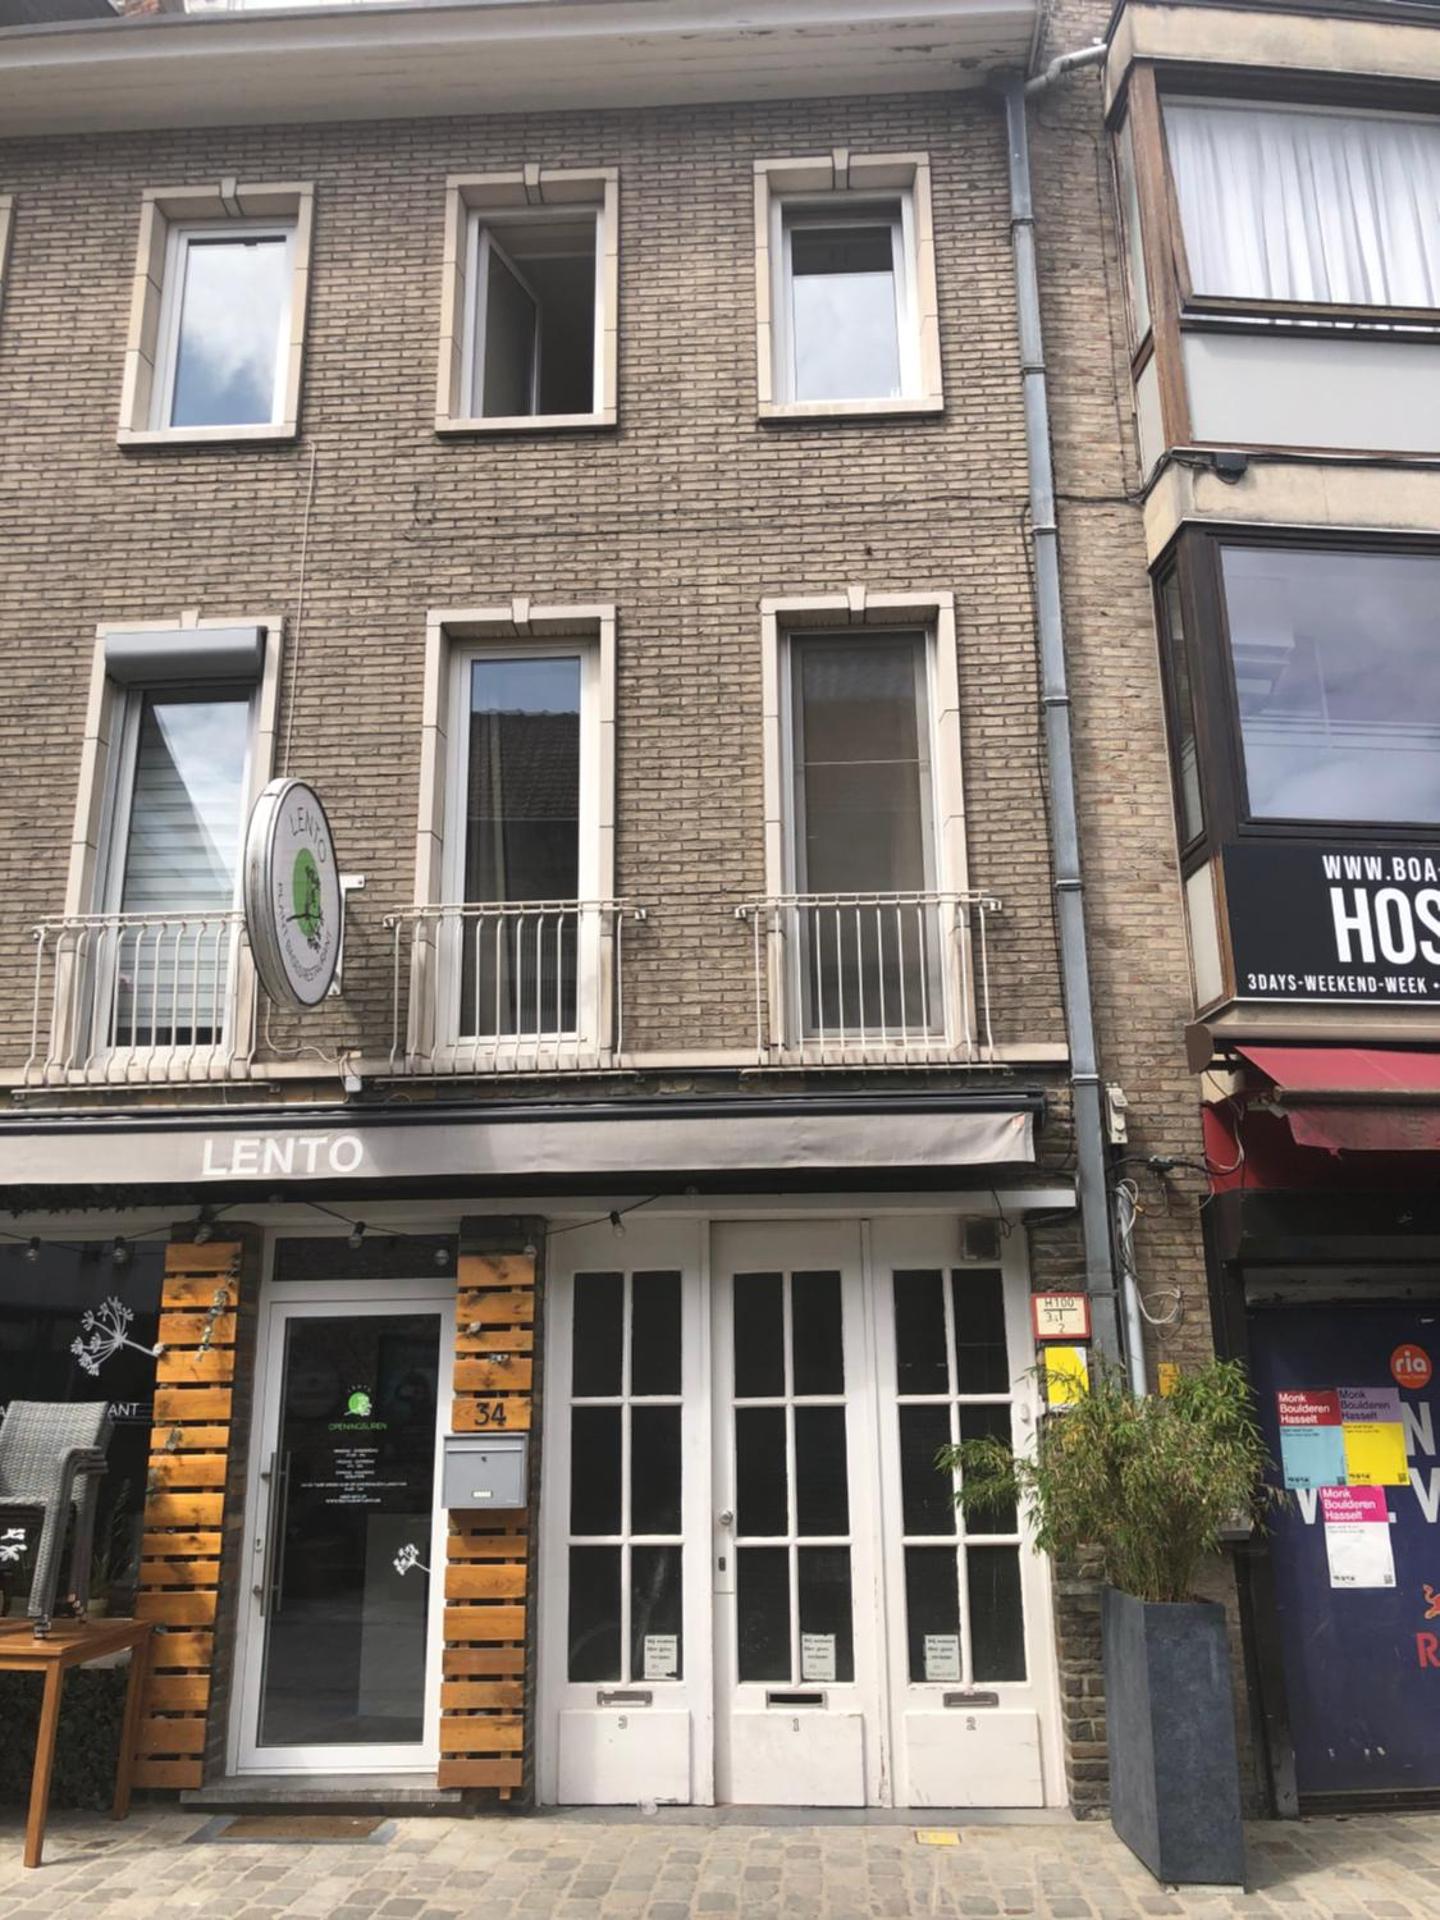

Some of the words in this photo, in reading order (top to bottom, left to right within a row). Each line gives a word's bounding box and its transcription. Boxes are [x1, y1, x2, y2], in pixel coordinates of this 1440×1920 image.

[289, 807, 327, 864] LENTO
[1322, 855, 1440, 882] WWW.BOA
[202, 1135, 364, 1176] LENTO
[1395, 1350, 1428, 1373] ria
[1278, 1393, 1306, 1403] Monk
[1340, 1390, 1366, 1399] Monk
[1279, 1403, 1330, 1414] Boulderen
[475, 1402, 507, 1427] 34
[1281, 1414, 1319, 1424] Hasselt
[1322, 1488, 1351, 1499] Monk
[1323, 1499, 1377, 1510] Boulderen
[1324, 1511, 1363, 1521] Hasselt
